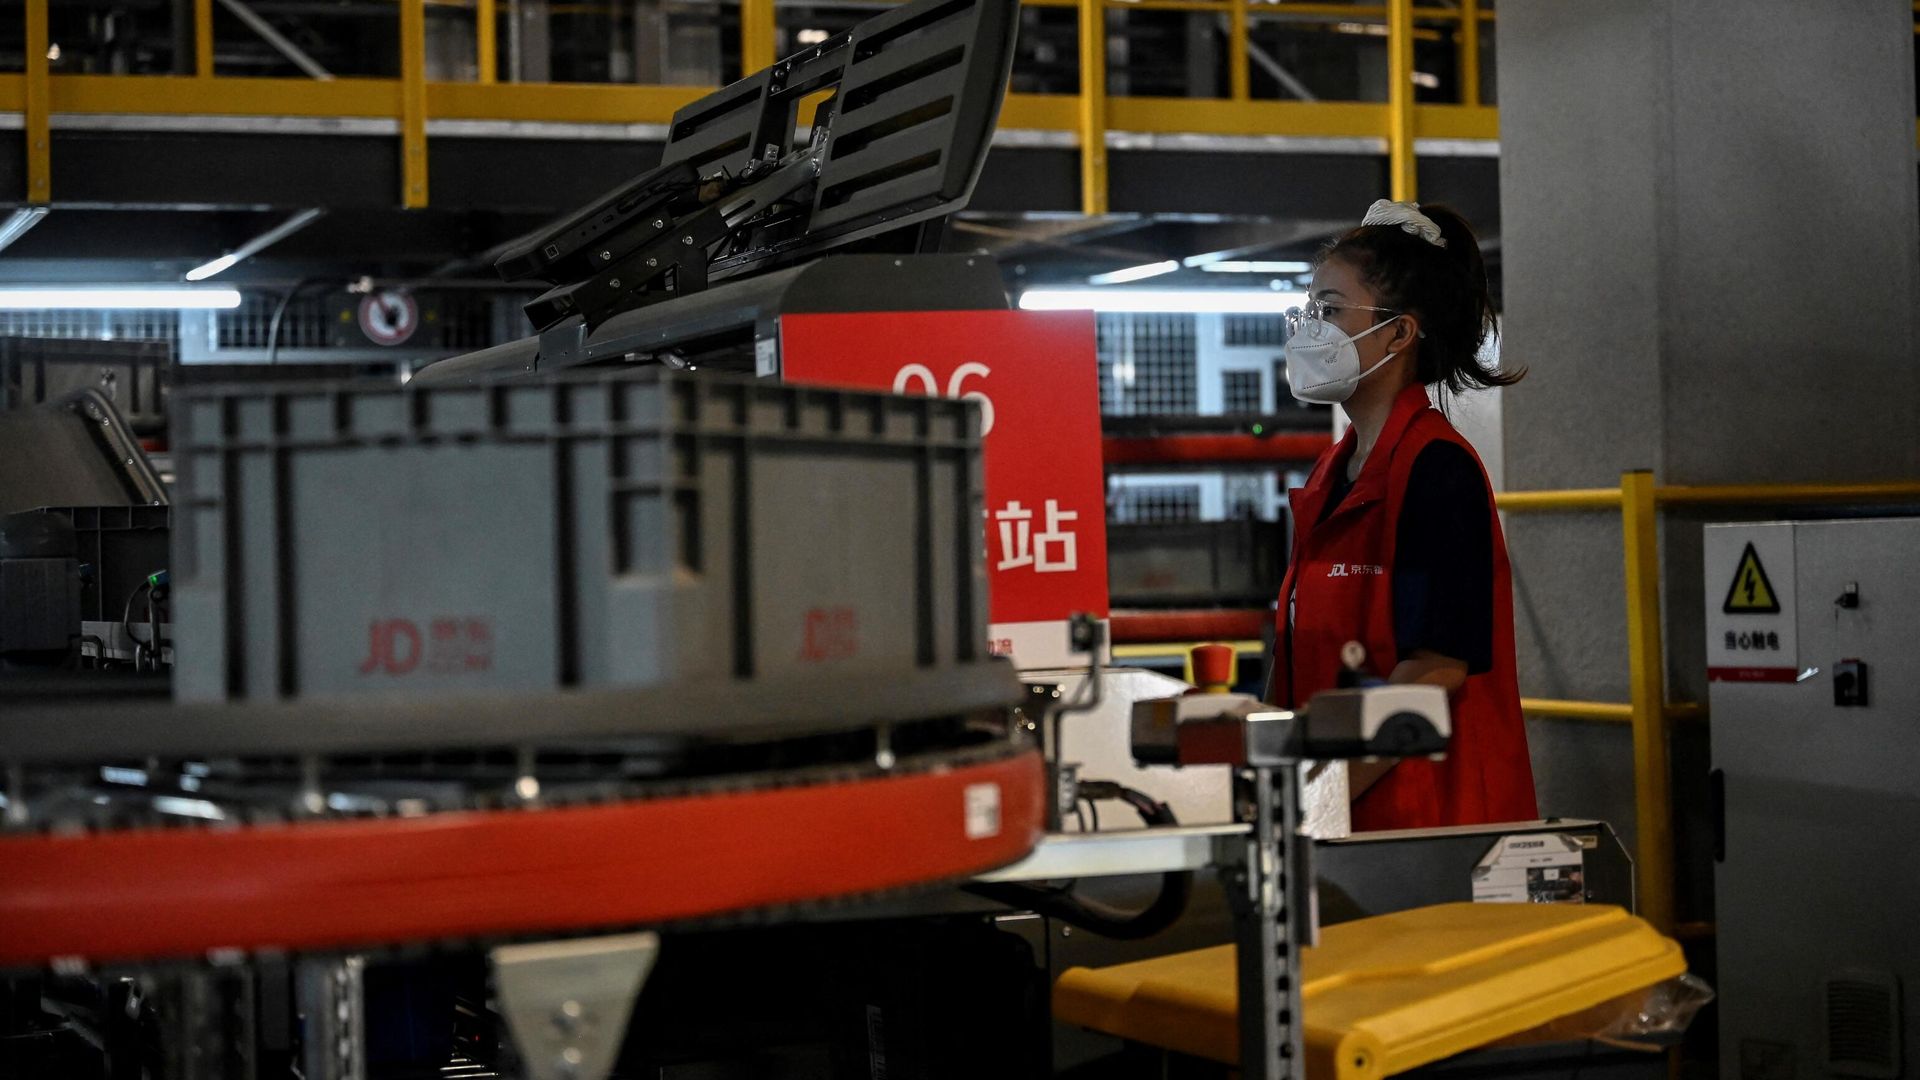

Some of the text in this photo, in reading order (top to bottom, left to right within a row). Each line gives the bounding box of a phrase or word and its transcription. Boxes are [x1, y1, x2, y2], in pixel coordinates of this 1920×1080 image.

[982, 499, 1078, 573] 站
[1327, 563, 1349, 577] JDL
[360, 617, 423, 676] JD
